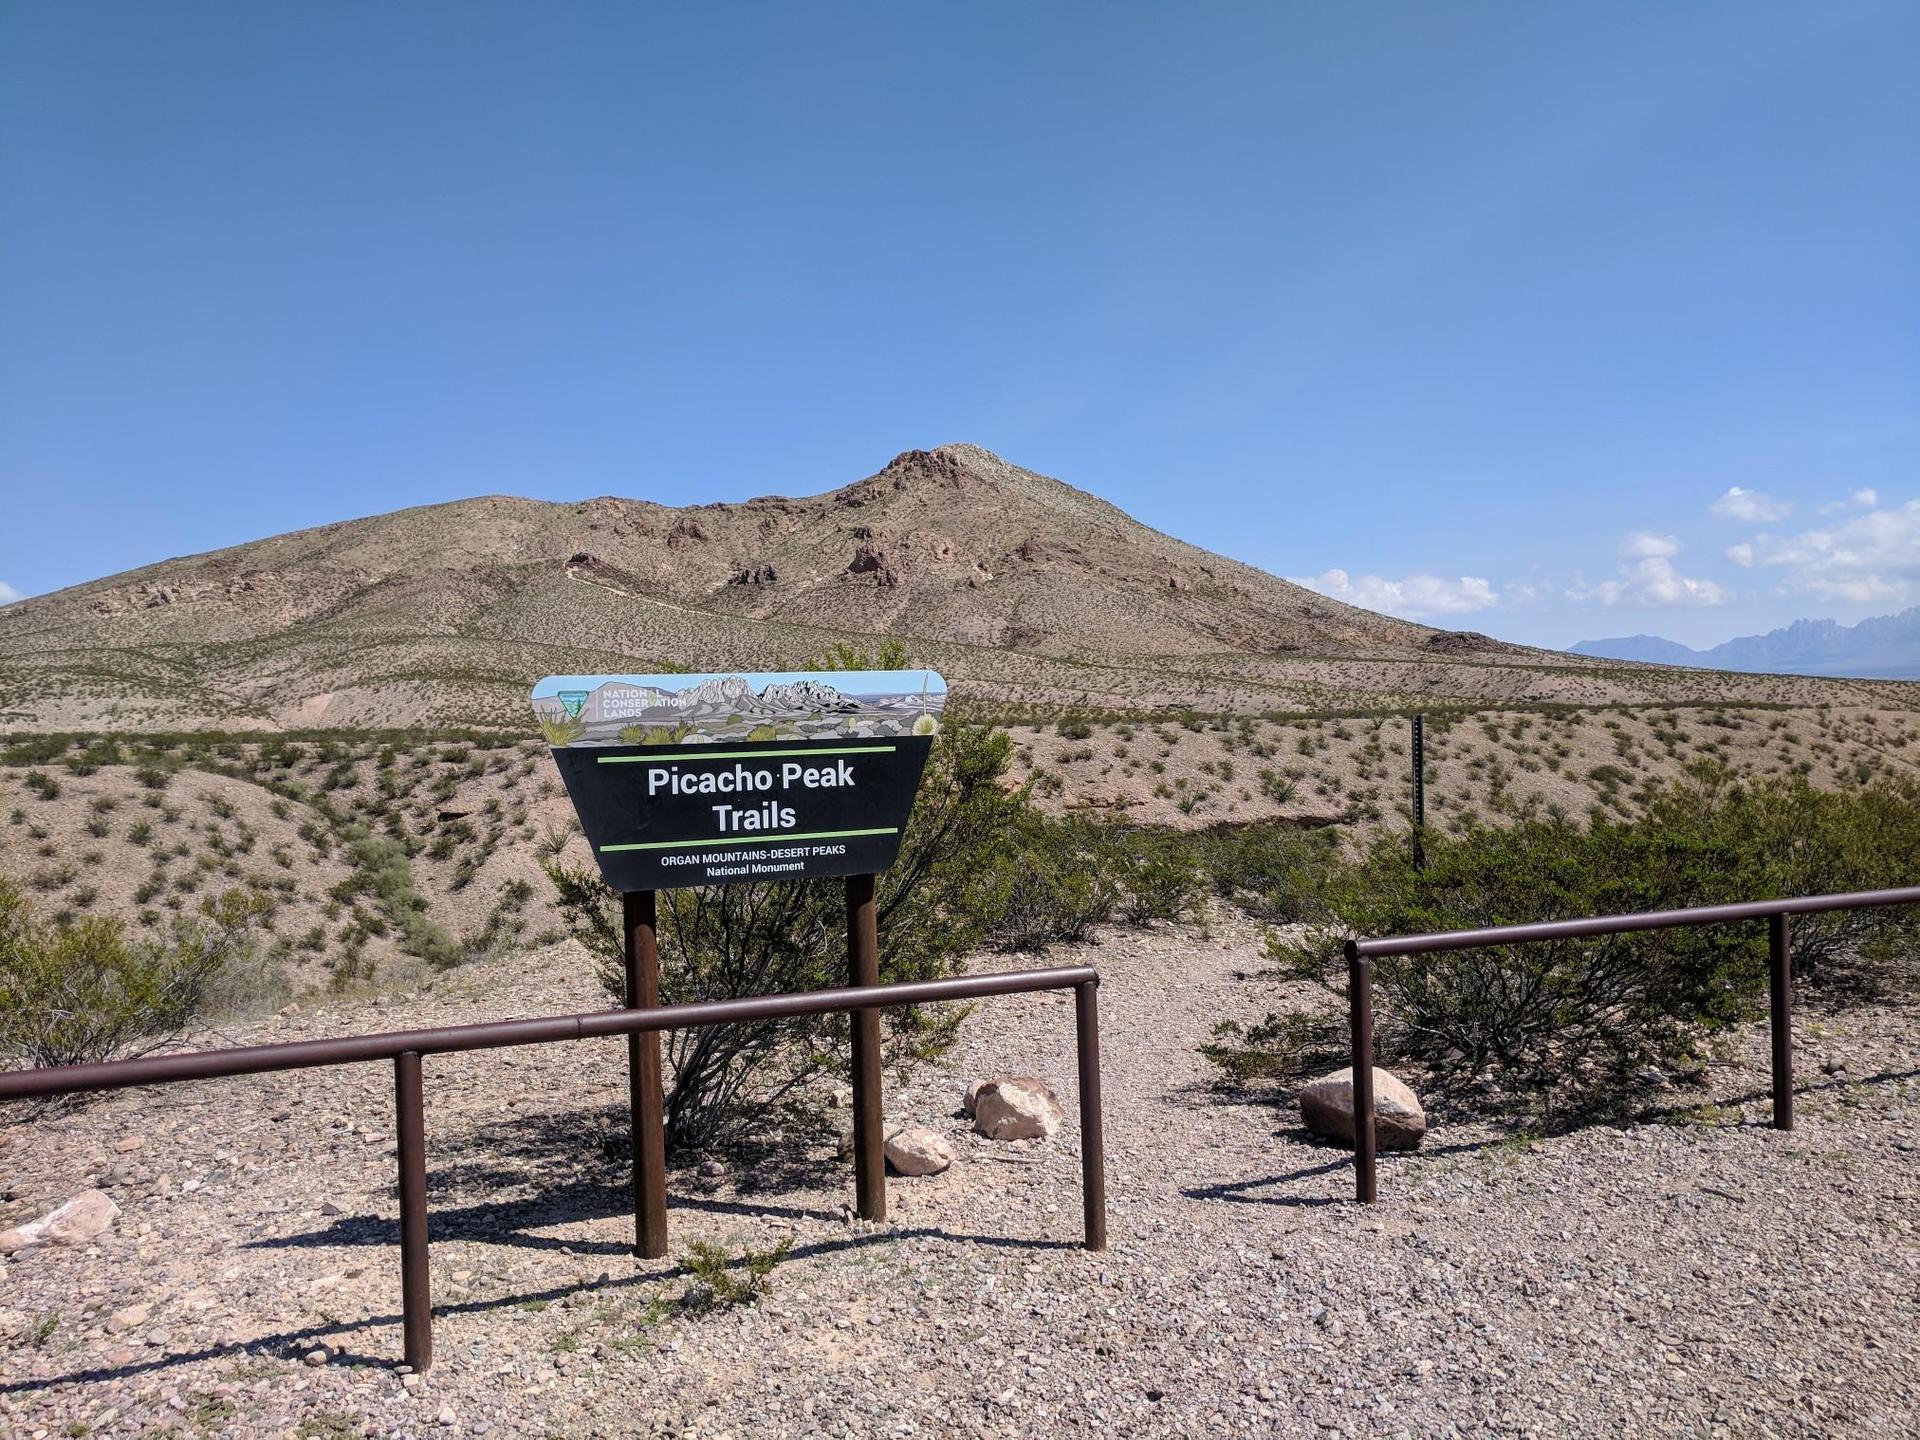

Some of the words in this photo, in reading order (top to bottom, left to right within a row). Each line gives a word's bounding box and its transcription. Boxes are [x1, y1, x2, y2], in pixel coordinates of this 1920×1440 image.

[603, 698, 686, 708] CONSERVATION
[604, 708, 642, 718] LANDS
[648, 764, 773, 795] Picacho
[782, 759, 855, 789] Peak
[712, 801, 796, 832] Trails
[661, 855, 700, 866] ORGAN
[702, 847, 810, 864] MOUNTAINS-DESERT
[813, 845, 846, 856] PEAKS
[706, 865, 750, 876] National
[751, 861, 805, 874] Monument
